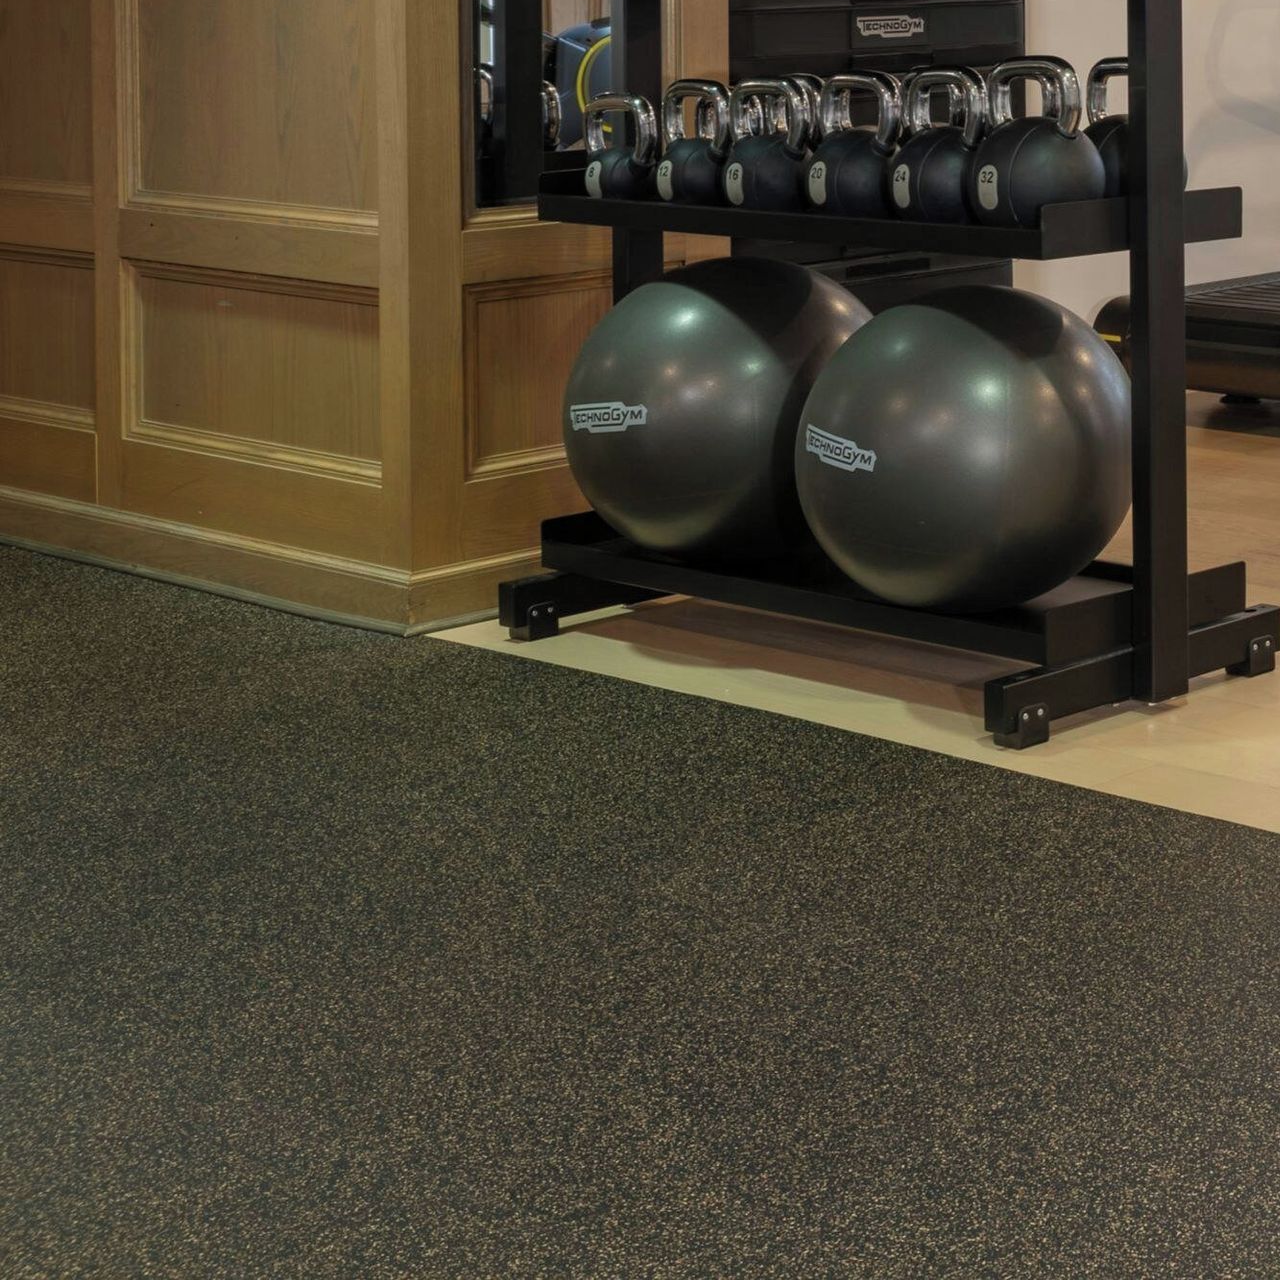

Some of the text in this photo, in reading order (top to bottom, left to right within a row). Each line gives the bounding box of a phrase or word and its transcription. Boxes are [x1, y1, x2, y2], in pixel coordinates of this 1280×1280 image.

[858, 18, 922, 35] TECHNOGYM
[660, 166, 669, 177] 12
[729, 169, 739, 180] 16
[811, 167, 823, 179] 20
[895, 170, 906, 182] 24
[981, 171, 994, 183] 32
[571, 405, 643, 429] TECHNOGYM
[807, 428, 874, 468] TECHNOGYM
